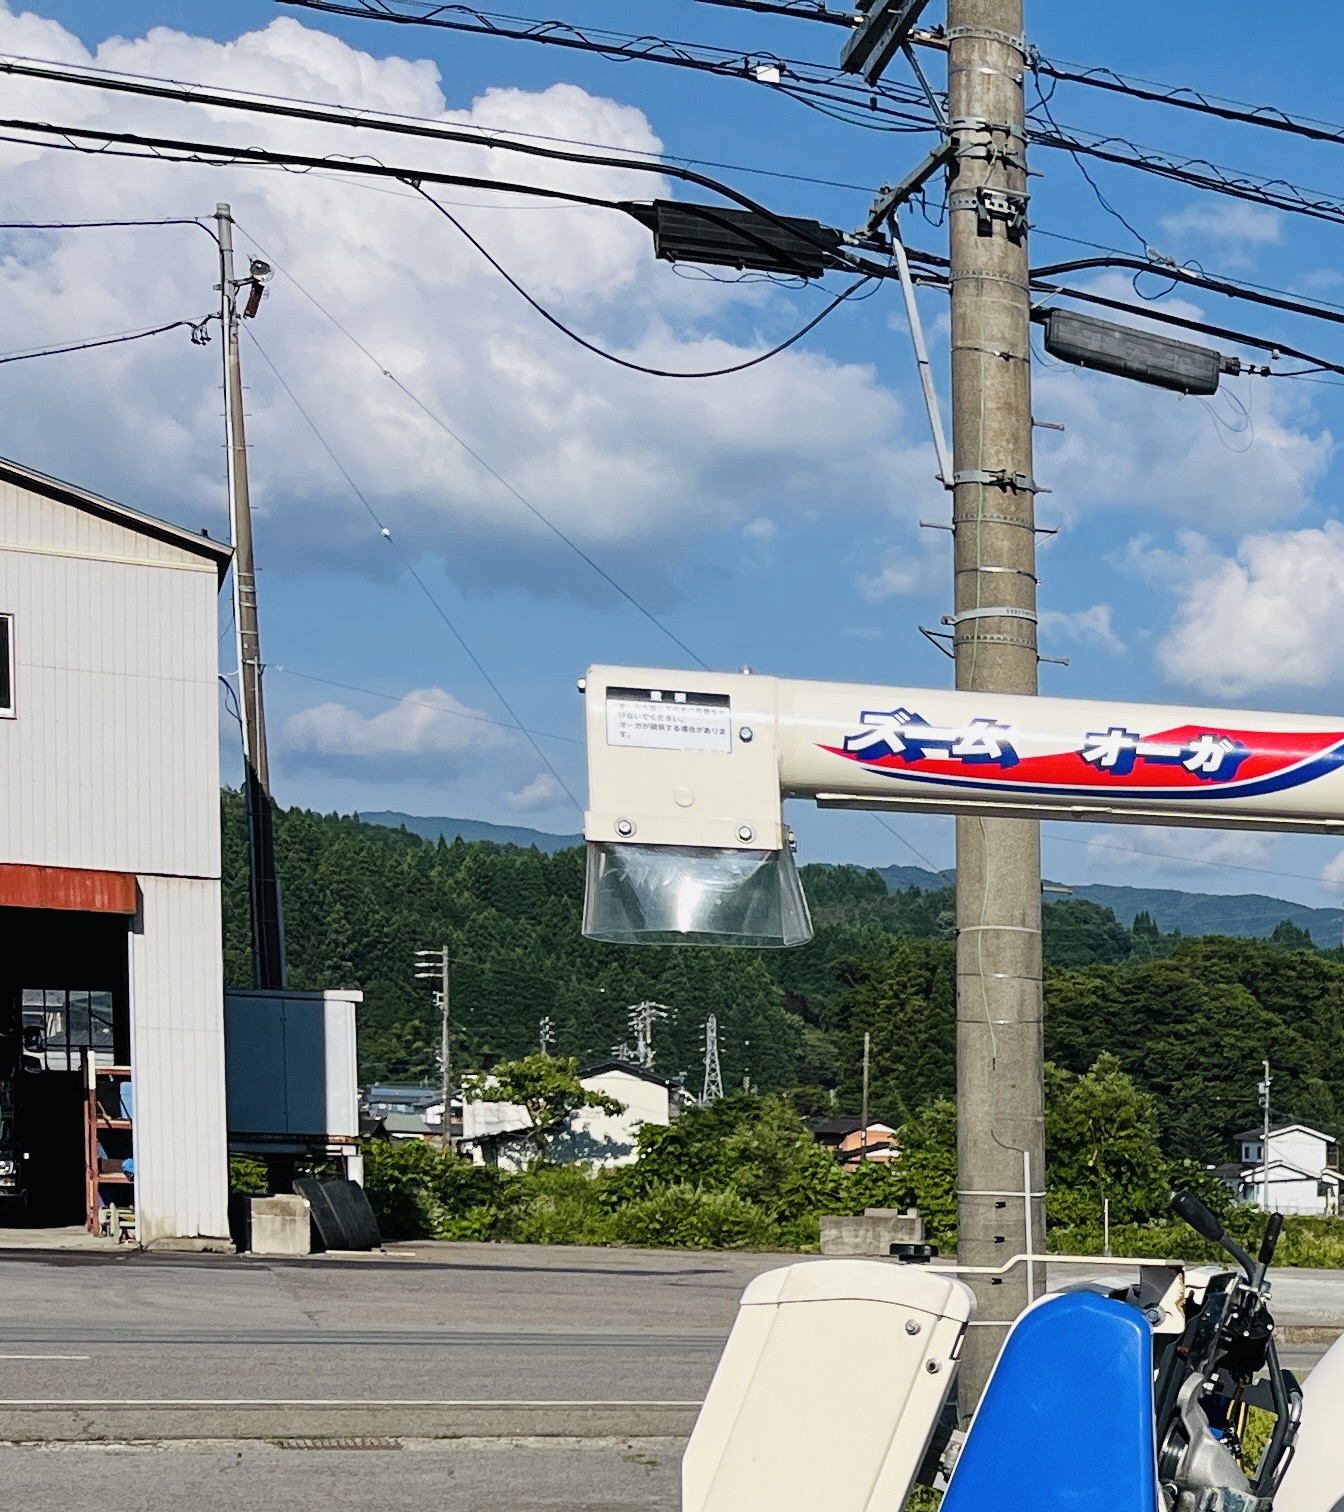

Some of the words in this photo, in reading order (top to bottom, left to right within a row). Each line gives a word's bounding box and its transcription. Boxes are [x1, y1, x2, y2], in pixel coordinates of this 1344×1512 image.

[845, 709, 1008, 761] ズーム
[1082, 728, 1235, 773] オーガ
